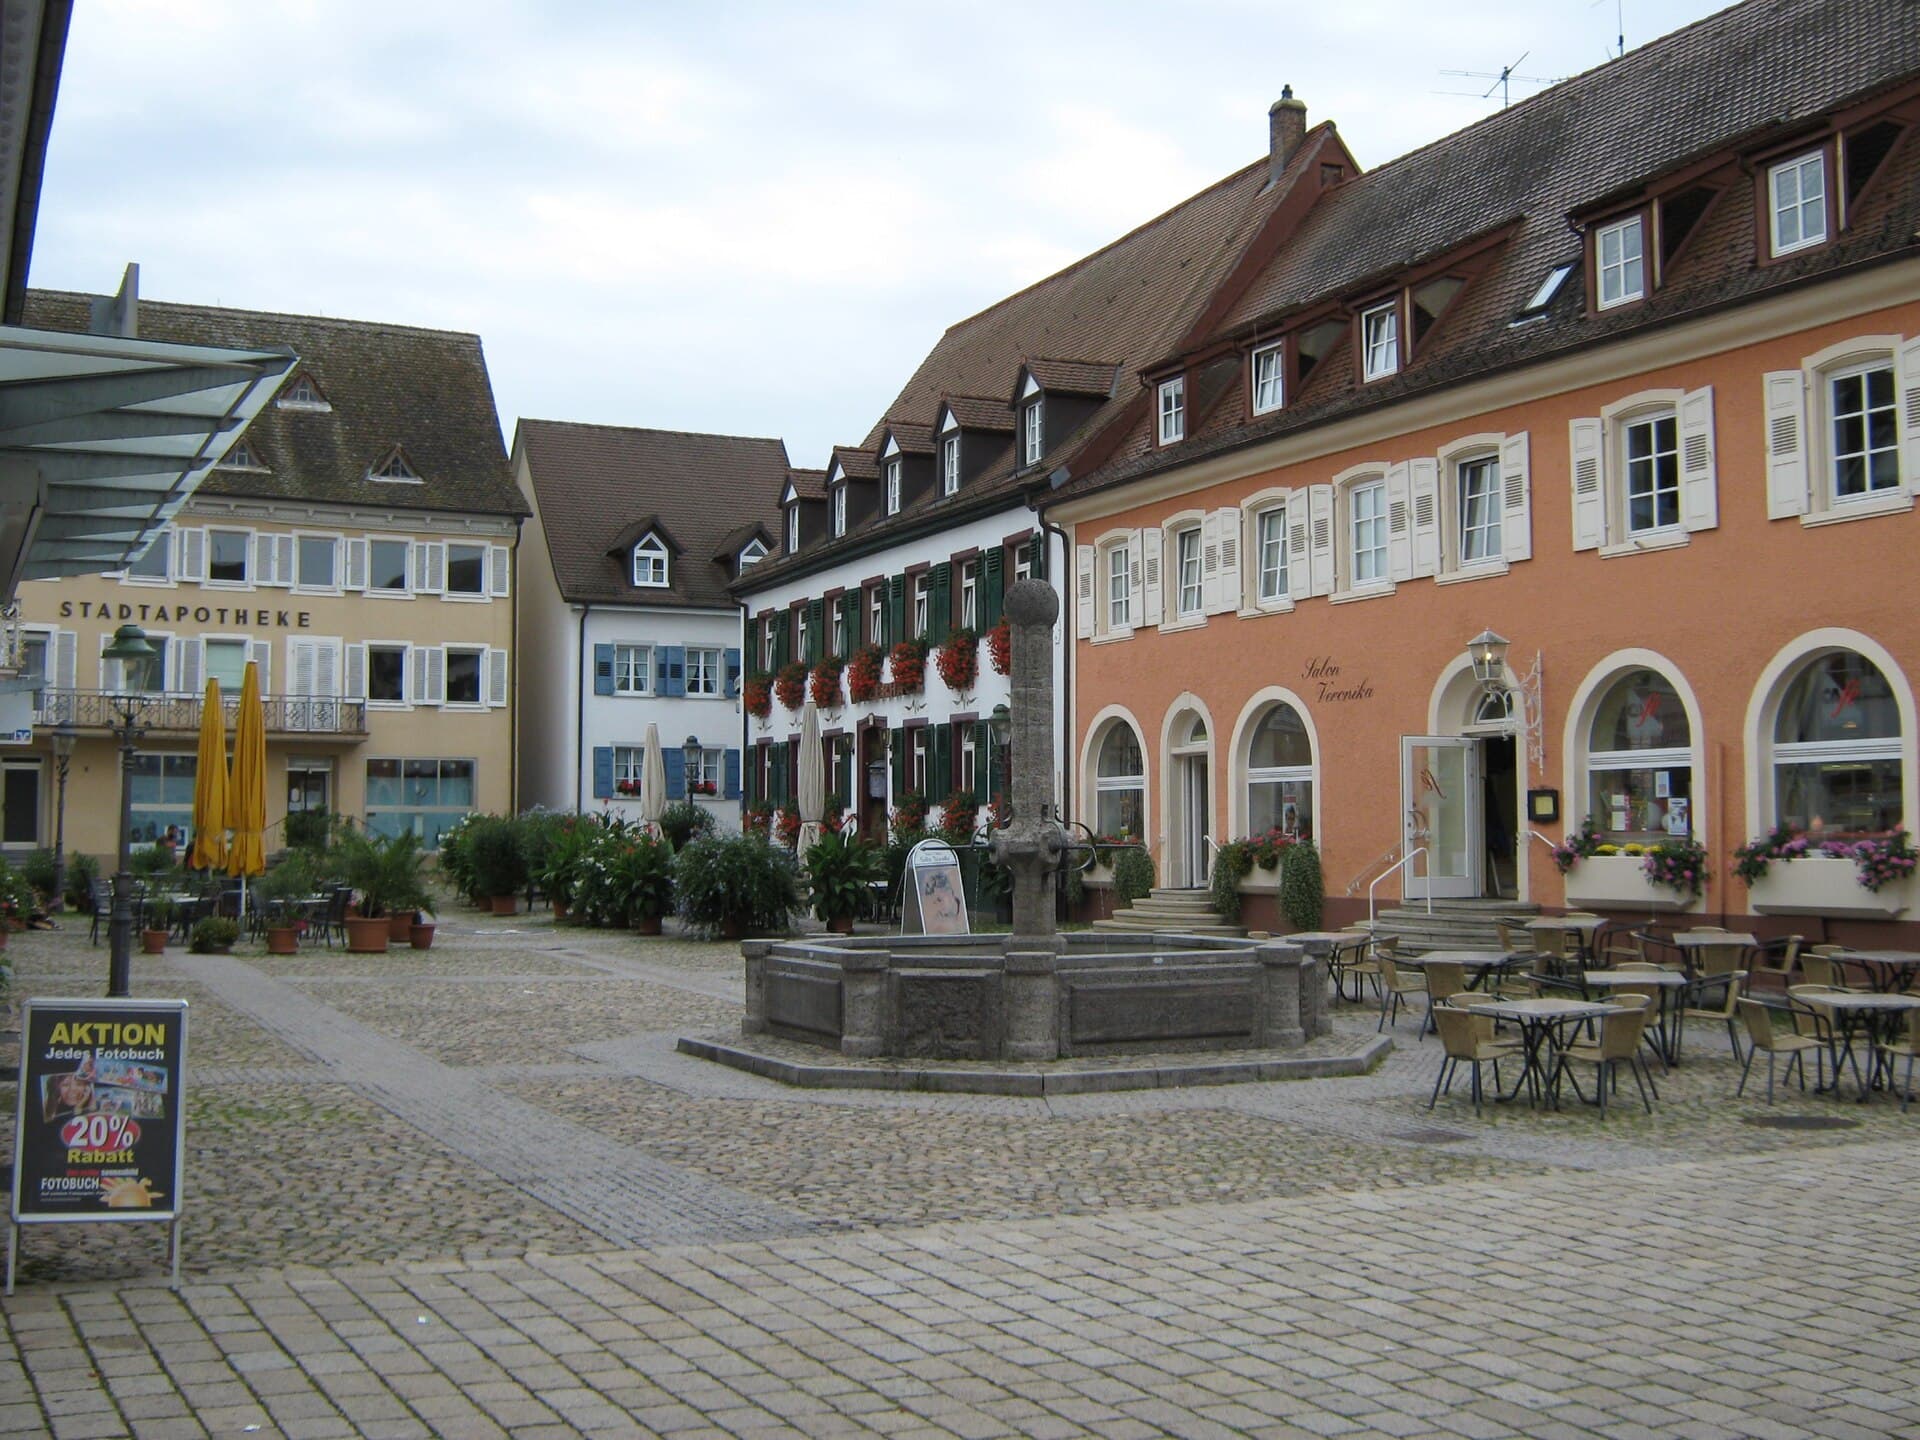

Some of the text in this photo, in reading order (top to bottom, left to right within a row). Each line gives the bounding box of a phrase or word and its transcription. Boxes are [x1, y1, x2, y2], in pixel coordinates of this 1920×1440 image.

[60, 600, 312, 628] STADTAPOTHEKE
[1301, 655, 1340, 679] Salon
[1317, 680, 1375, 704] Veronika
[49, 1022, 166, 1046] AKTION
[45, 1047, 164, 1060] Jedes Fotobuch
[68, 1114, 134, 1148] 20%
[67, 1149, 135, 1164] Rabatt
[40, 1177, 99, 1190] FOTOBUCH
